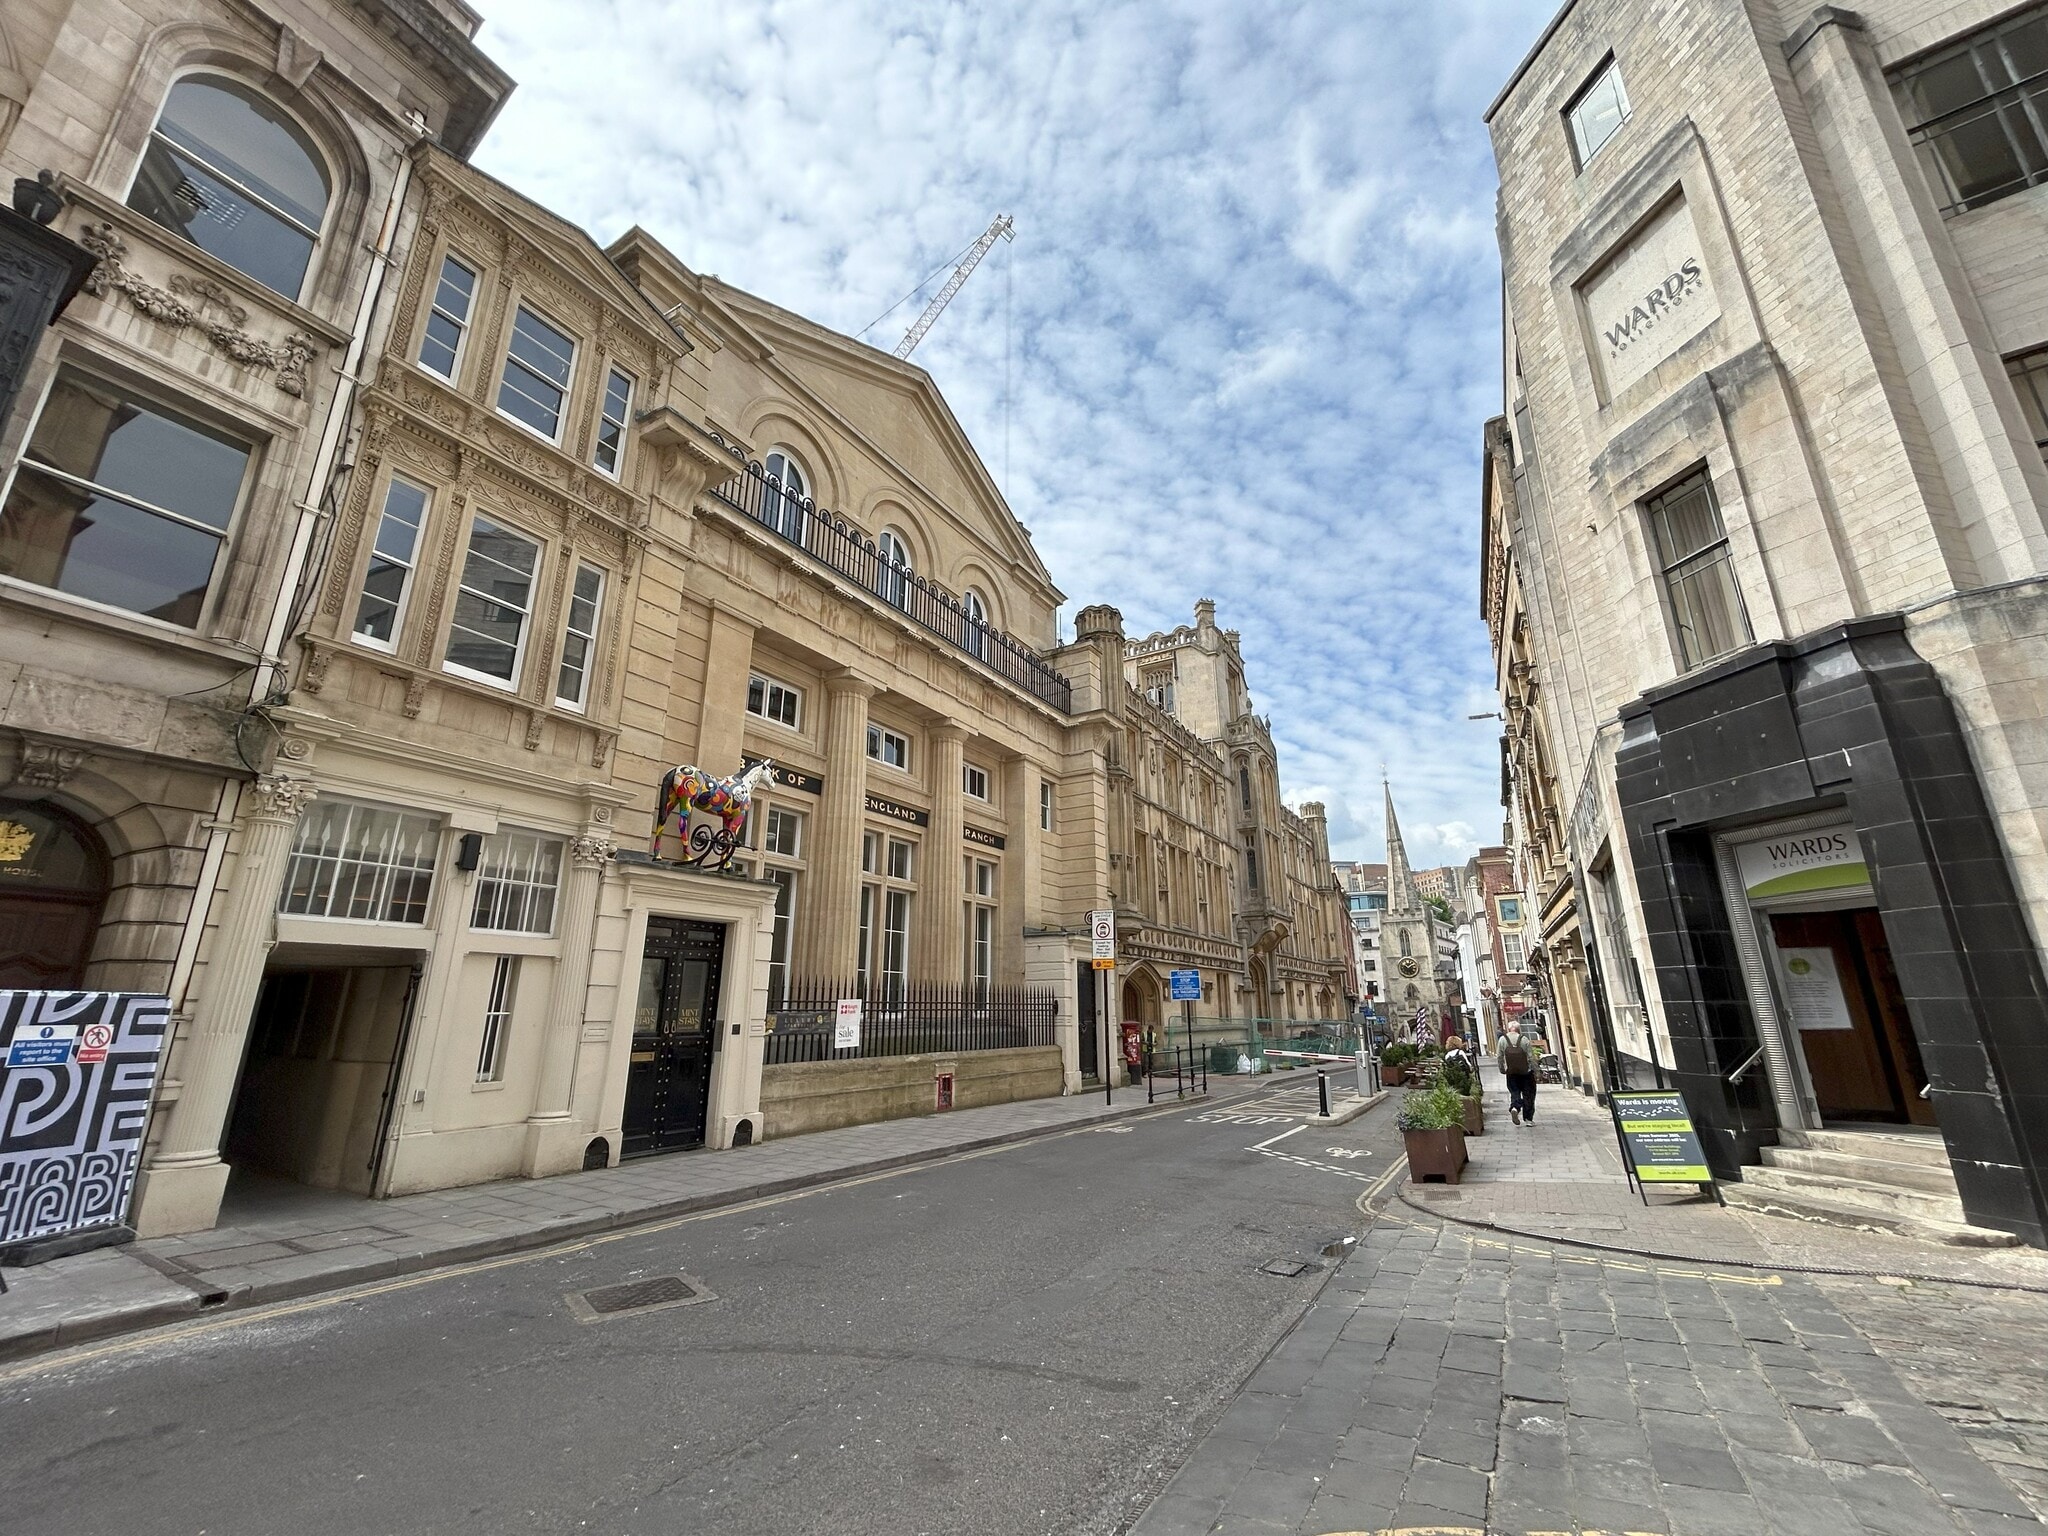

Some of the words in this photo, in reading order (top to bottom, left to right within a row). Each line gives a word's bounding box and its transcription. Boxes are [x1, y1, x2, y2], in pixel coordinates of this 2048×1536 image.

[1602, 256, 1701, 347] WARDS
[1610, 278, 1703, 359] SOLICITORS
[740, 757, 780, 780] BK
[787, 773, 806, 786] OF
[864, 797, 917, 821] ENGLAND
[964, 828, 995, 845] RANCH
[1766, 833, 1848, 861] WARDS
[1772, 852, 1850, 870] SOLICITORS
[679, 1016, 700, 1025] STAYS
[681, 1008, 699, 1017] MINT
[838, 1027, 854, 1039] sale
[1617, 1098, 1641, 1106] Wards
[1649, 1097, 1679, 1106] moving
[1183, 1114, 1295, 1125] STOP
